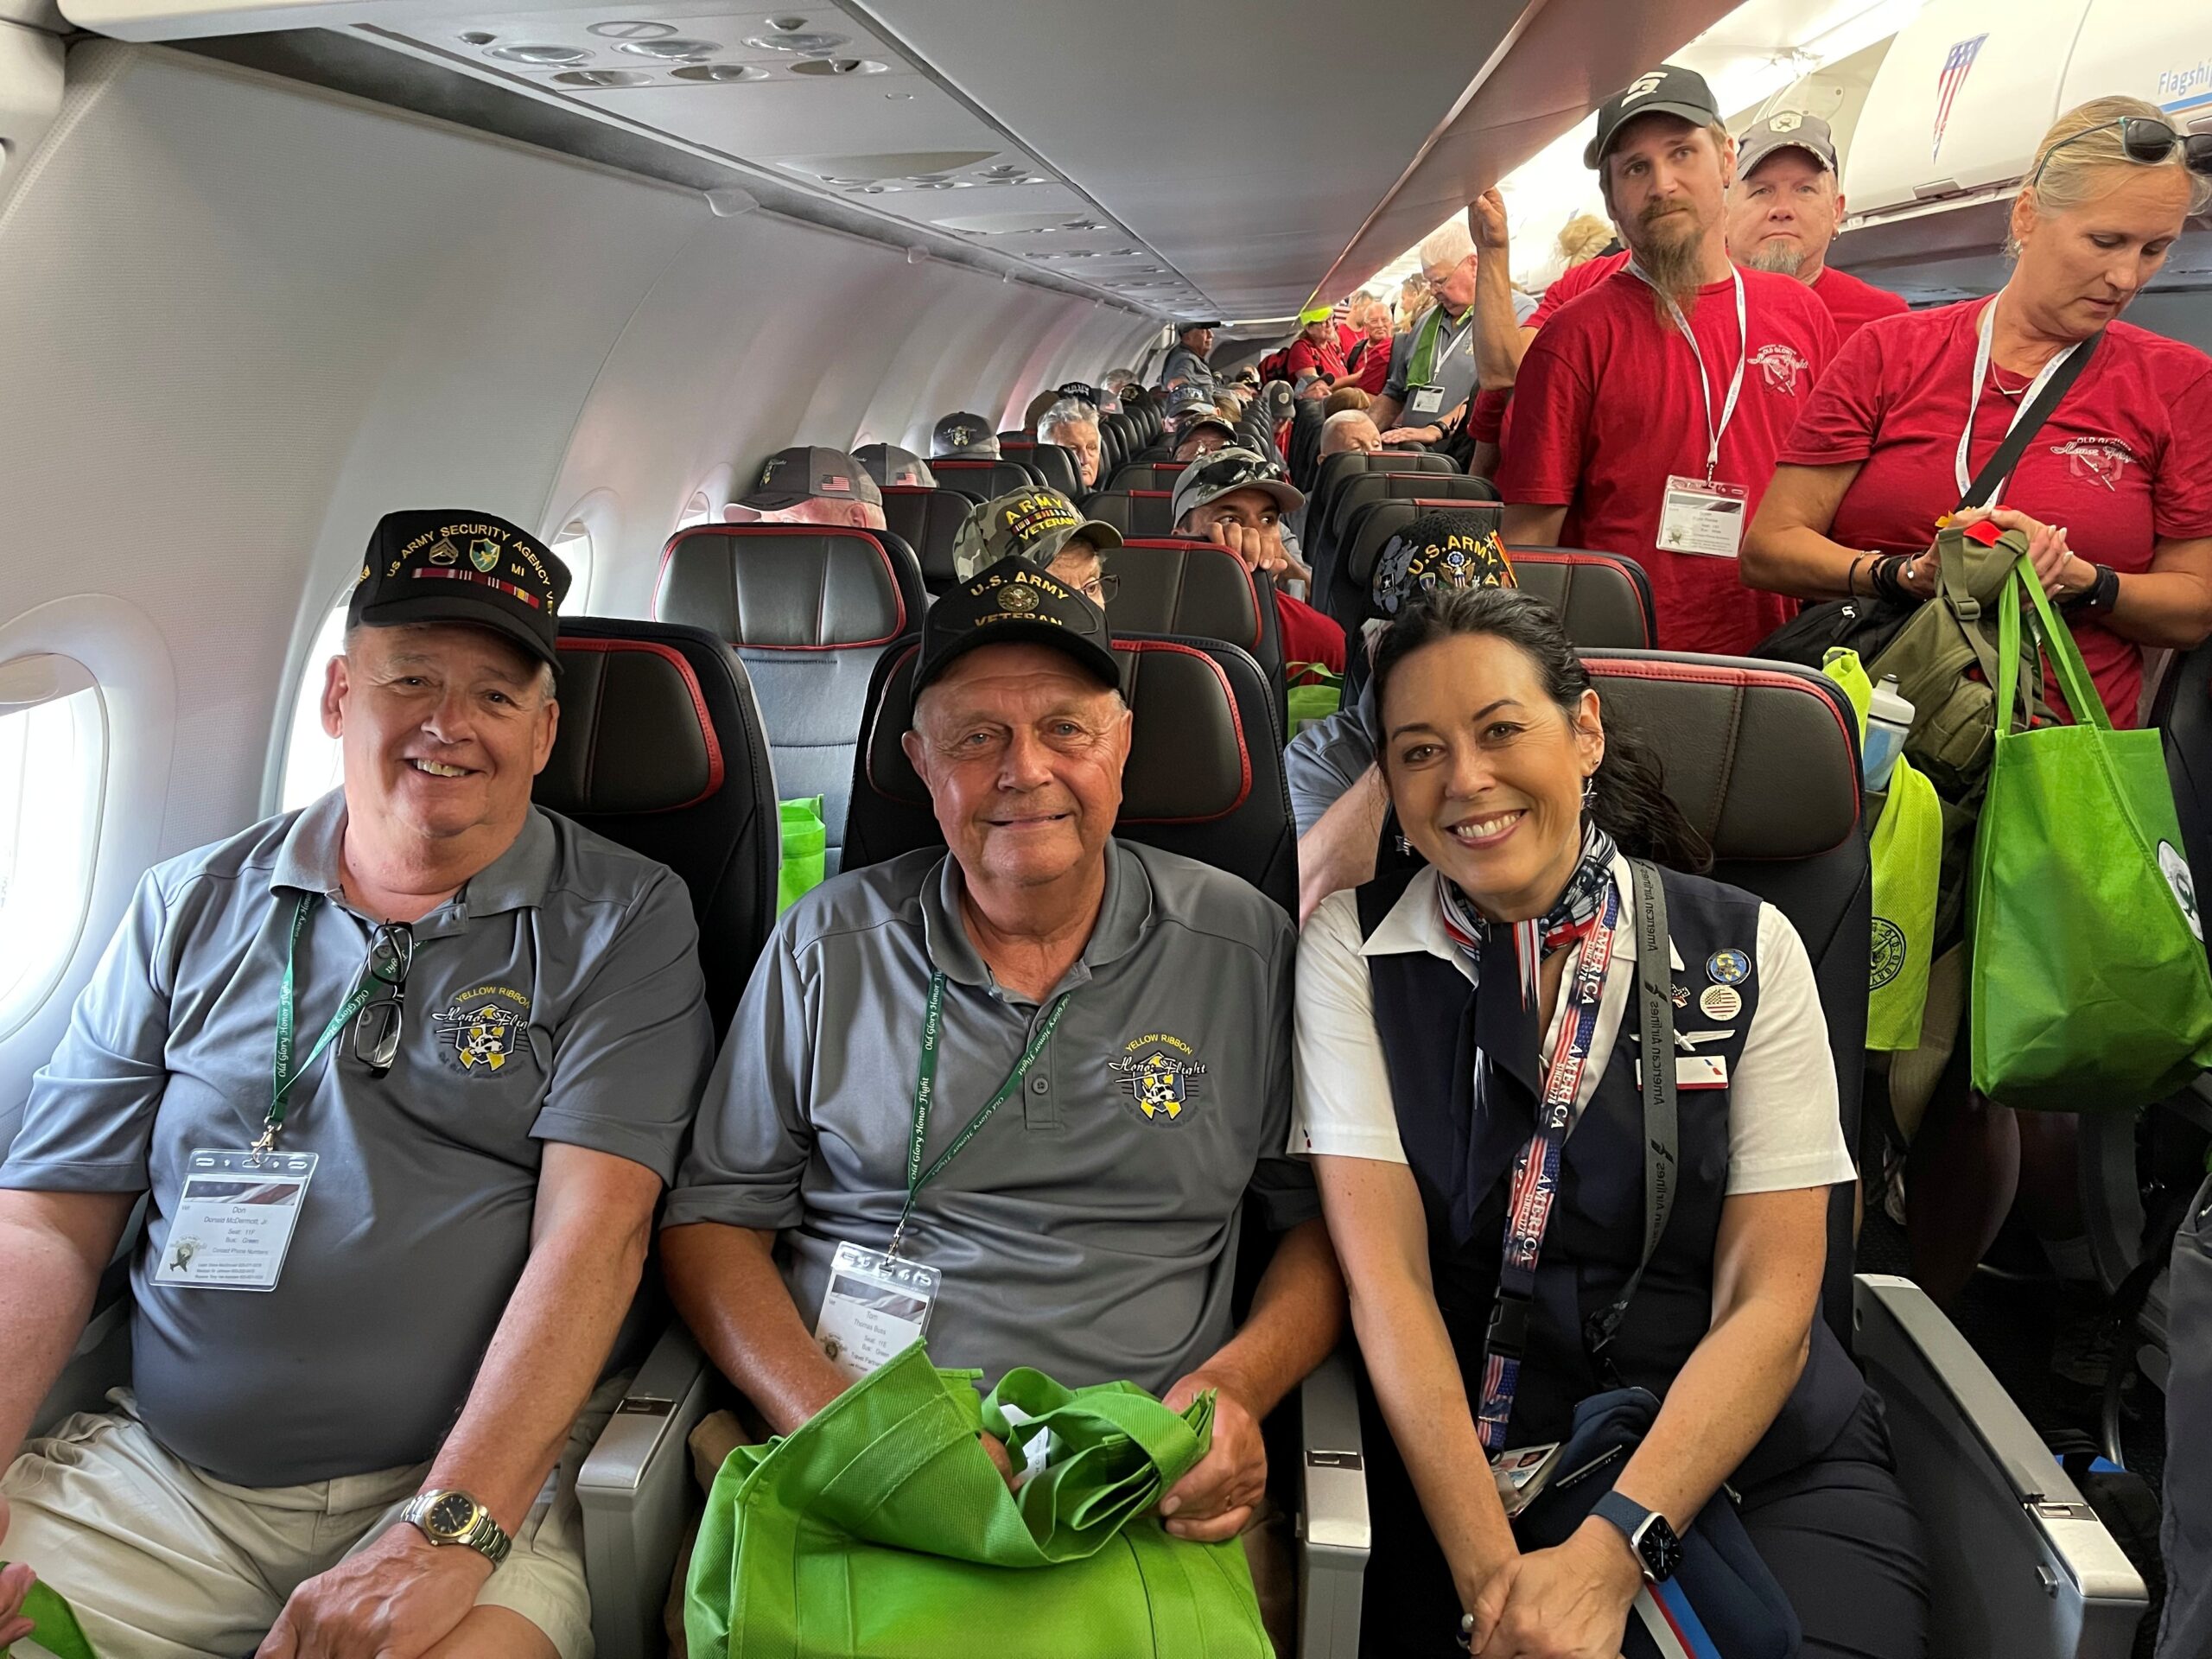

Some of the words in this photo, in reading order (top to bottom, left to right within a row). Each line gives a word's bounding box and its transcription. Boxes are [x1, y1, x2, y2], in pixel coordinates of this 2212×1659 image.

[2158, 58, 2212, 96] Flagshi
[1005, 494, 1064, 524] ARMY
[1020, 516, 1077, 541] VETERAN
[386, 561, 401, 577] US
[401, 531, 435, 560] ARMY
[440, 523, 511, 541] SECURITY
[512, 541, 550, 585] AGENCY
[1408, 543, 1446, 575] U.S.
[1447, 535, 1497, 566] ARMY
[512, 563, 525, 576] MI
[970, 575, 1008, 596] U.S.
[1014, 571, 1070, 600] ARMY
[1583, 940, 1595, 962] SINCE
[1581, 924, 1609, 1004] AMERICA
[354, 989, 370, 1006] Old
[455, 986, 497, 1003] YELLOW
[930, 984, 940, 1010] Honor
[279, 1008, 289, 1036] Honor
[335, 1003, 357, 1024] Glory
[926, 1011, 939, 1034] Glory
[278, 1037, 290, 1061] Glory
[925, 1034, 933, 1051] Old
[1034, 1027, 1052, 1053] Honor
[1125, 1034, 1159, 1052] YELLOW
[1161, 1034, 1193, 1055] RIBBON
[277, 1061, 287, 1077] Old
[1018, 1051, 1036, 1077] Flight
[1160, 1057, 1206, 1077] Flight
[1551, 1062, 1564, 1086] SINCE
[918, 1077, 931, 1104] Flight
[1551, 1044, 1583, 1128] AMERICA
[992, 1096, 1004, 1111] Old
[916, 1106, 925, 1135] Honor
[912, 1136, 925, 1162] Glory
[1521, 1193, 1533, 1218] SINCE
[1521, 1173, 1552, 1262] AMERICA
[867, 1311, 878, 1321] Tom
